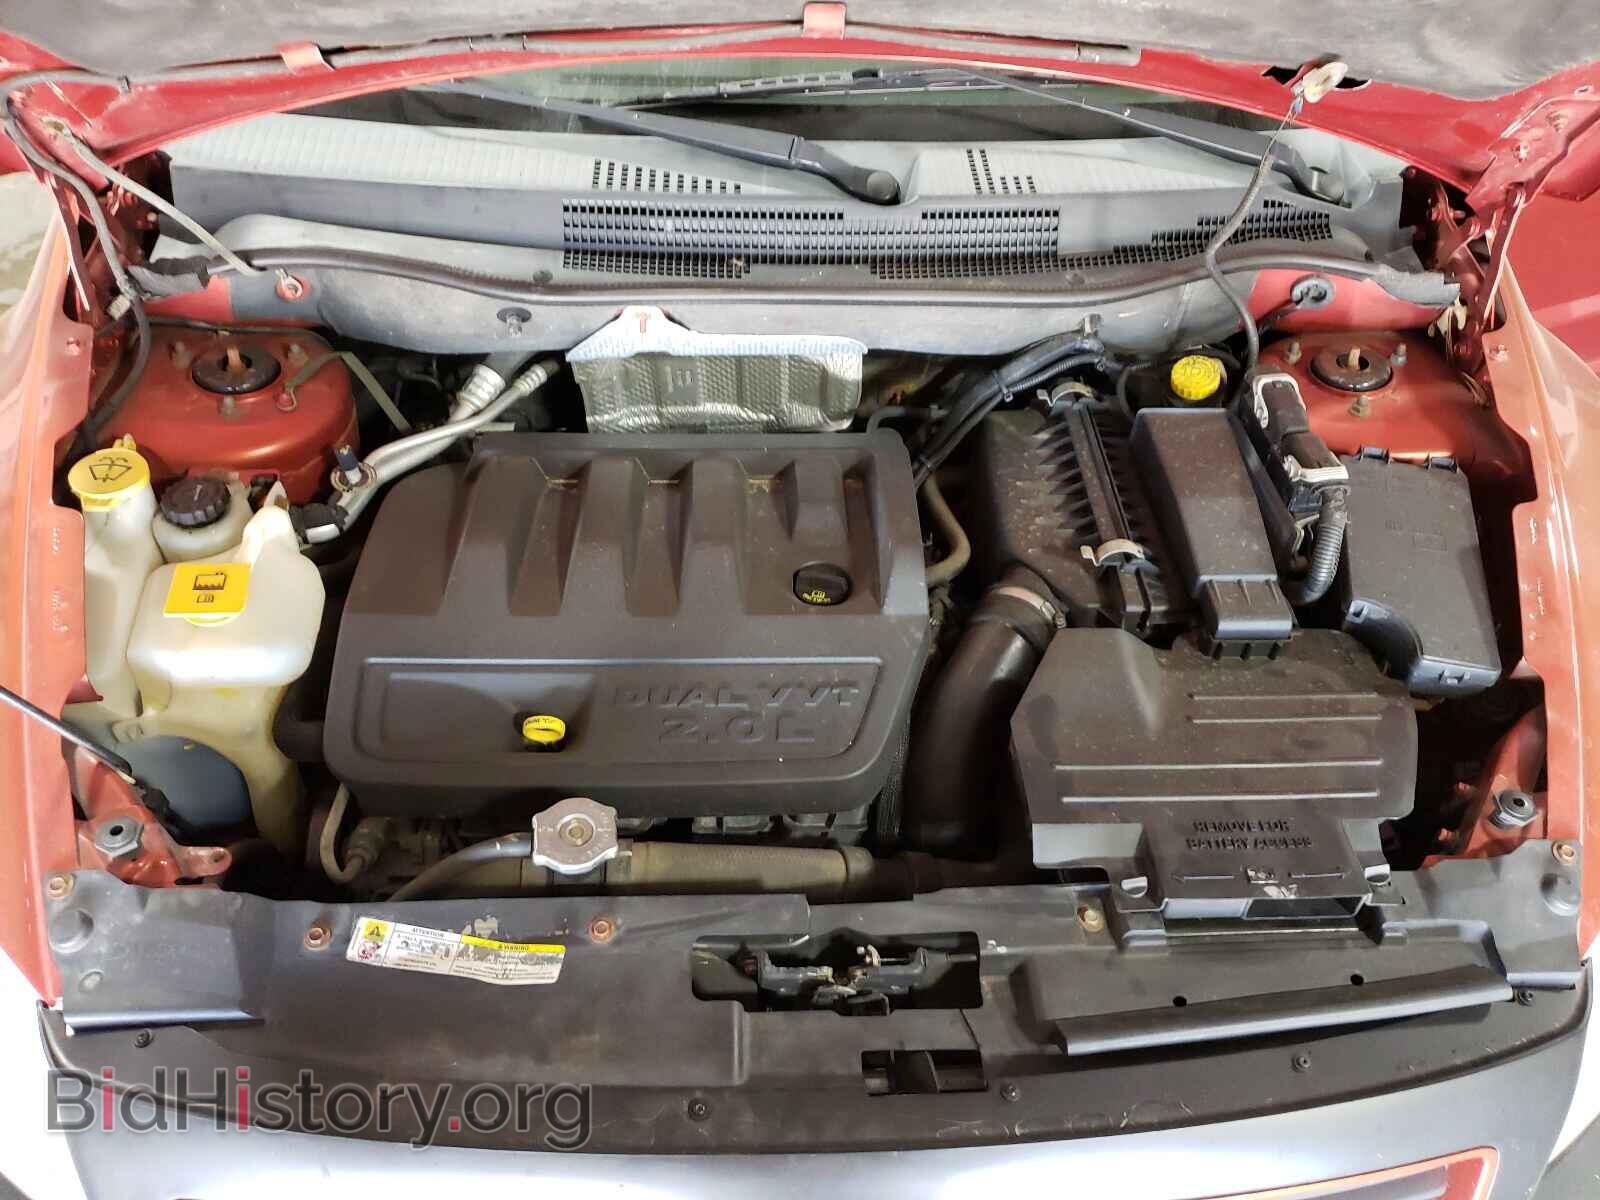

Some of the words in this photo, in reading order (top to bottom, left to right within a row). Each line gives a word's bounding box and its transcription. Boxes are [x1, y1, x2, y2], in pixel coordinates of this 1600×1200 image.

[613, 685, 750, 708] DUAL
[658, 713, 816, 745] 2.0L
[1192, 820, 1254, 832] REMOVE
[1257, 819, 1290, 832] FOR
[1185, 838, 1249, 850] BATTERY
[1253, 837, 1312, 849] ACCESS
